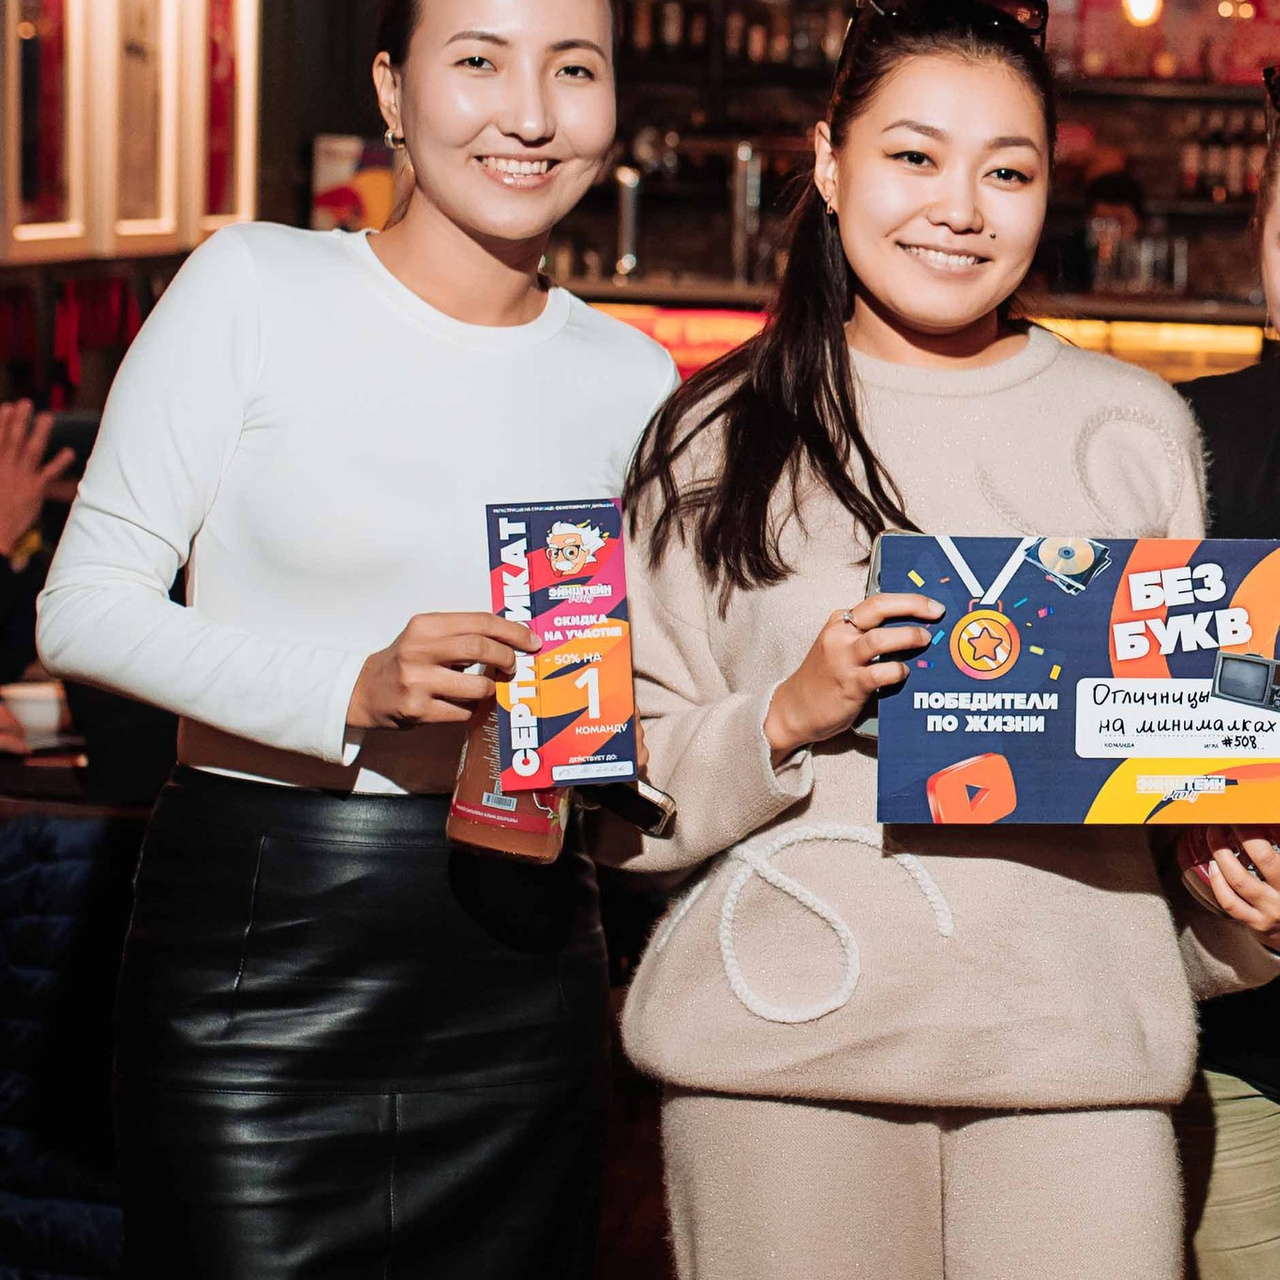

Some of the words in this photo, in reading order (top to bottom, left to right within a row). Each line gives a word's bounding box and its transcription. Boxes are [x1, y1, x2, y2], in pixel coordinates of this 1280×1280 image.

[1127, 563, 1227, 612] БЕЗ
[553, 614, 609, 627] СКИДКА
[544, 630, 563, 641] НА
[565, 626, 622, 640] УЧАСТИЕ
[1112, 607, 1253, 662] БУКВ
[499, 517, 541, 777] СЕРТИИКАТ
[554, 653, 581, 665] 50%
[584, 652, 603, 663] НА
[574, 667, 601, 720] 1
[913, 691, 1059, 712] ПОБЕДИТЕЛИ
[1092, 683, 1211, 709] Отличницы
[575, 723, 628, 735] КОМАНДУ
[927, 714, 958, 733] ПО
[963, 714, 1045, 733] ЖИЗНИ
[1099, 718, 1126, 735] на
[1136, 718, 1278, 734] минималках
[1221, 735, 1258, 749] #508
[569, 754, 605, 764] ДЕЙСТВУЕТ
